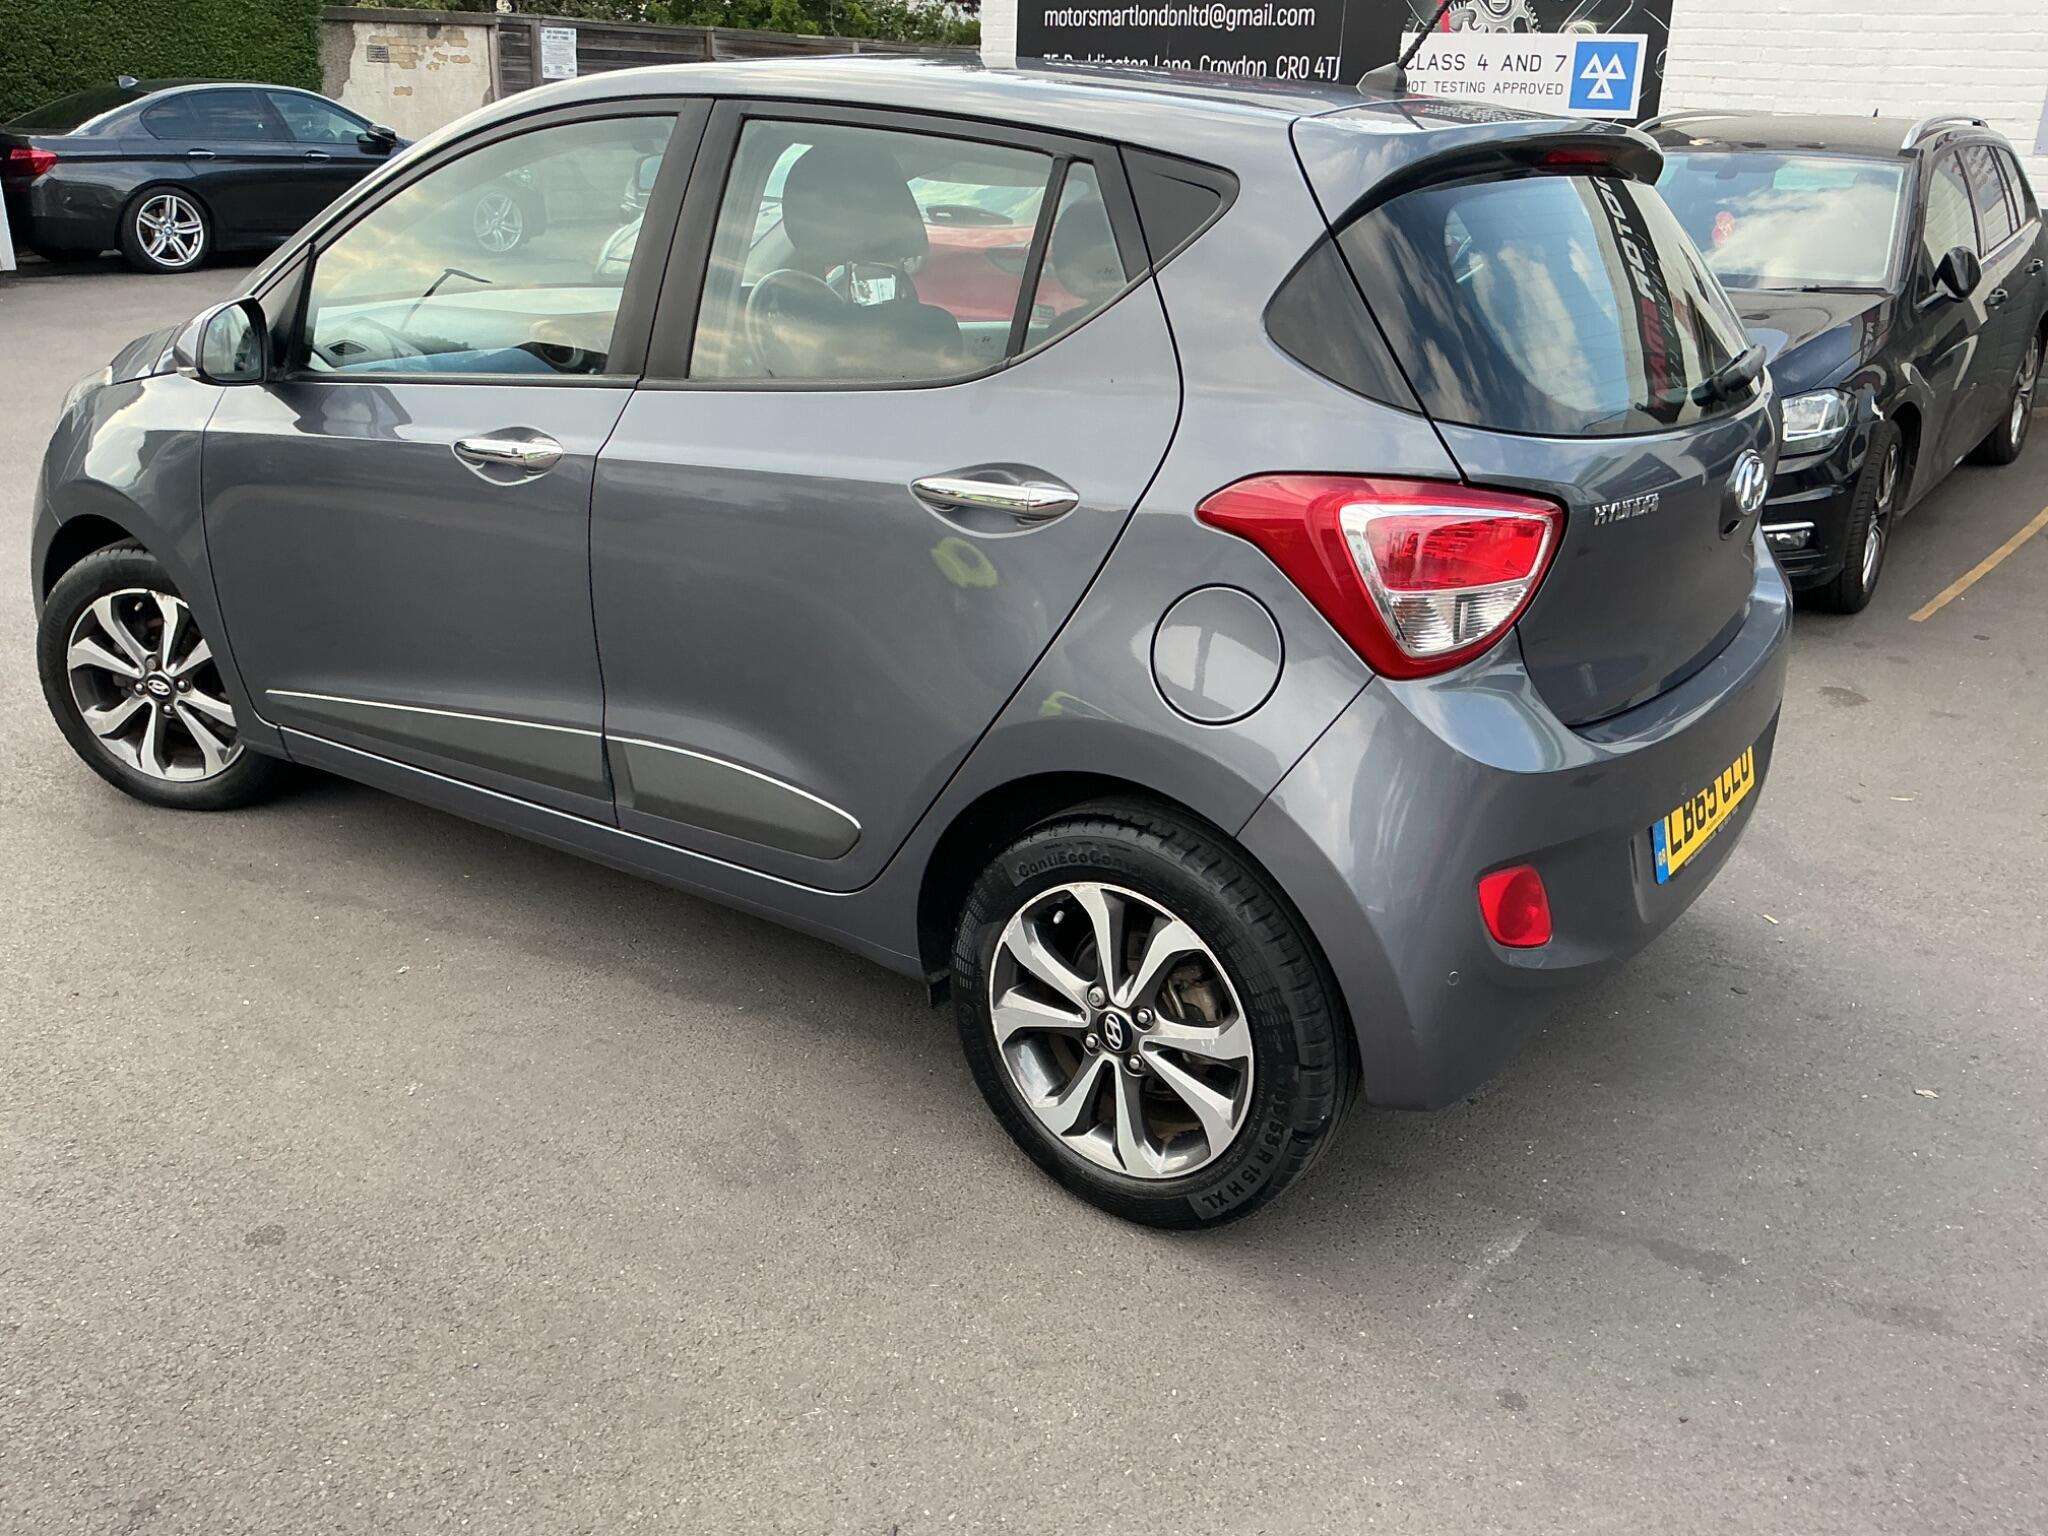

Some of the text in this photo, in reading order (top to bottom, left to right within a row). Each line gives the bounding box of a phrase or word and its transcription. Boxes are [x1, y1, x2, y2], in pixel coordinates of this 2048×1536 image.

[1044, 3, 1316, 32] motorsmartlondonltd@gmail.com
[1314, 56, 1341, 81] 4TJ
[1477, 54, 1489, 71] 4
[1501, 54, 1542, 72] AND
[1555, 55, 1568, 73] 7
[1433, 81, 1486, 94] TESTING
[1493, 82, 1564, 95] APPROVED
